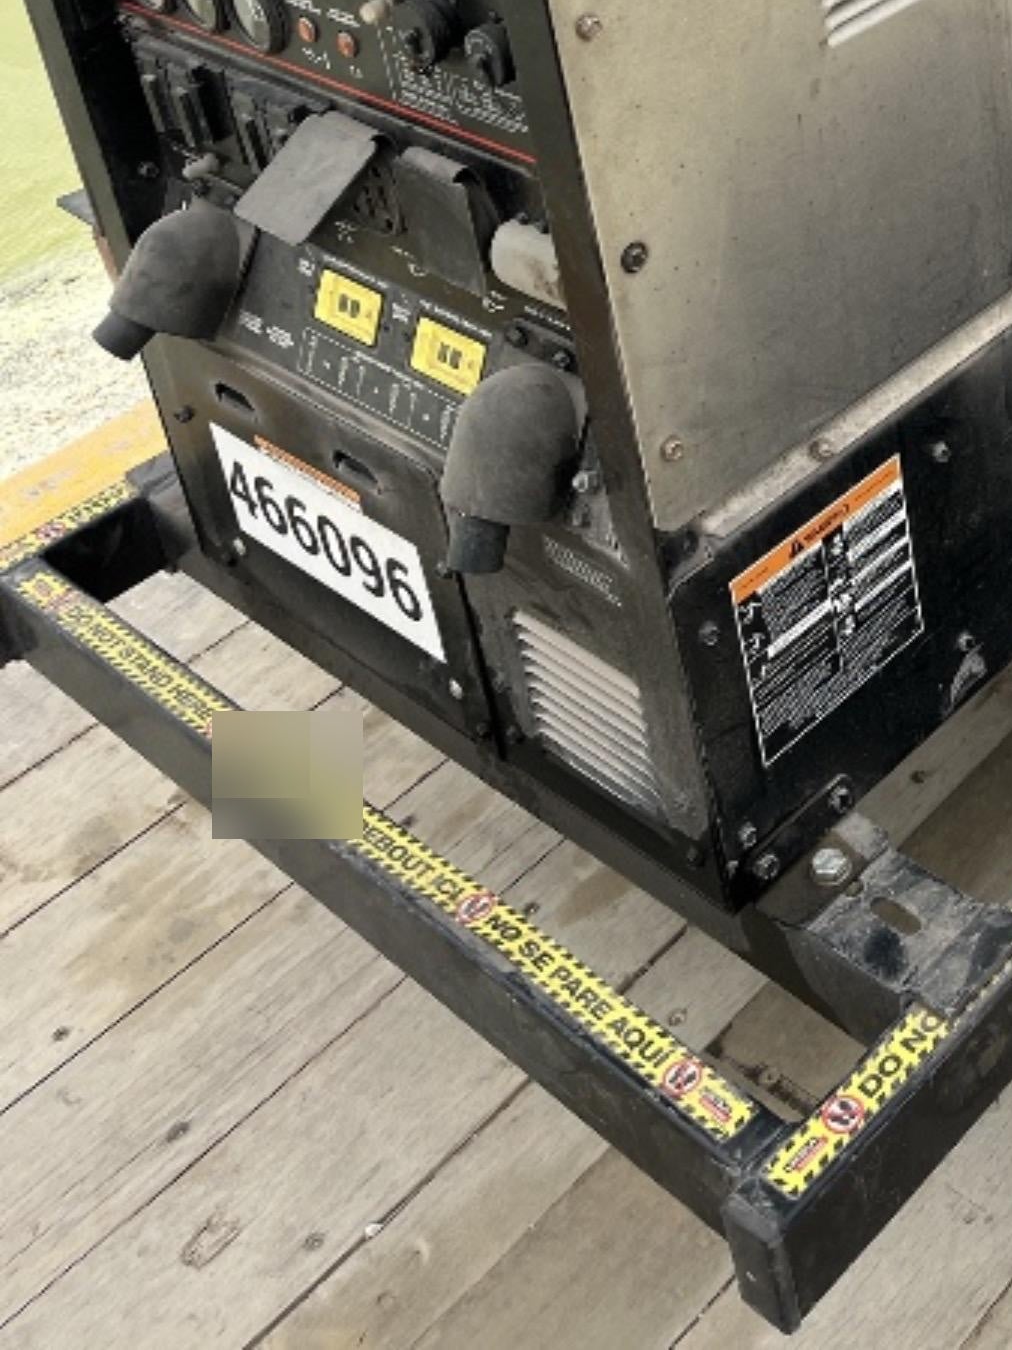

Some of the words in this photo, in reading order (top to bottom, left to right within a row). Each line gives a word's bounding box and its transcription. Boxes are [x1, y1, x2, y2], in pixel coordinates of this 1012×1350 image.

[230, 459, 424, 623] 466096
[483, 913, 523, 942] NO
[518, 938, 556, 973] SE
[548, 965, 615, 1021] PARE
[858, 1054, 903, 1100] DO
